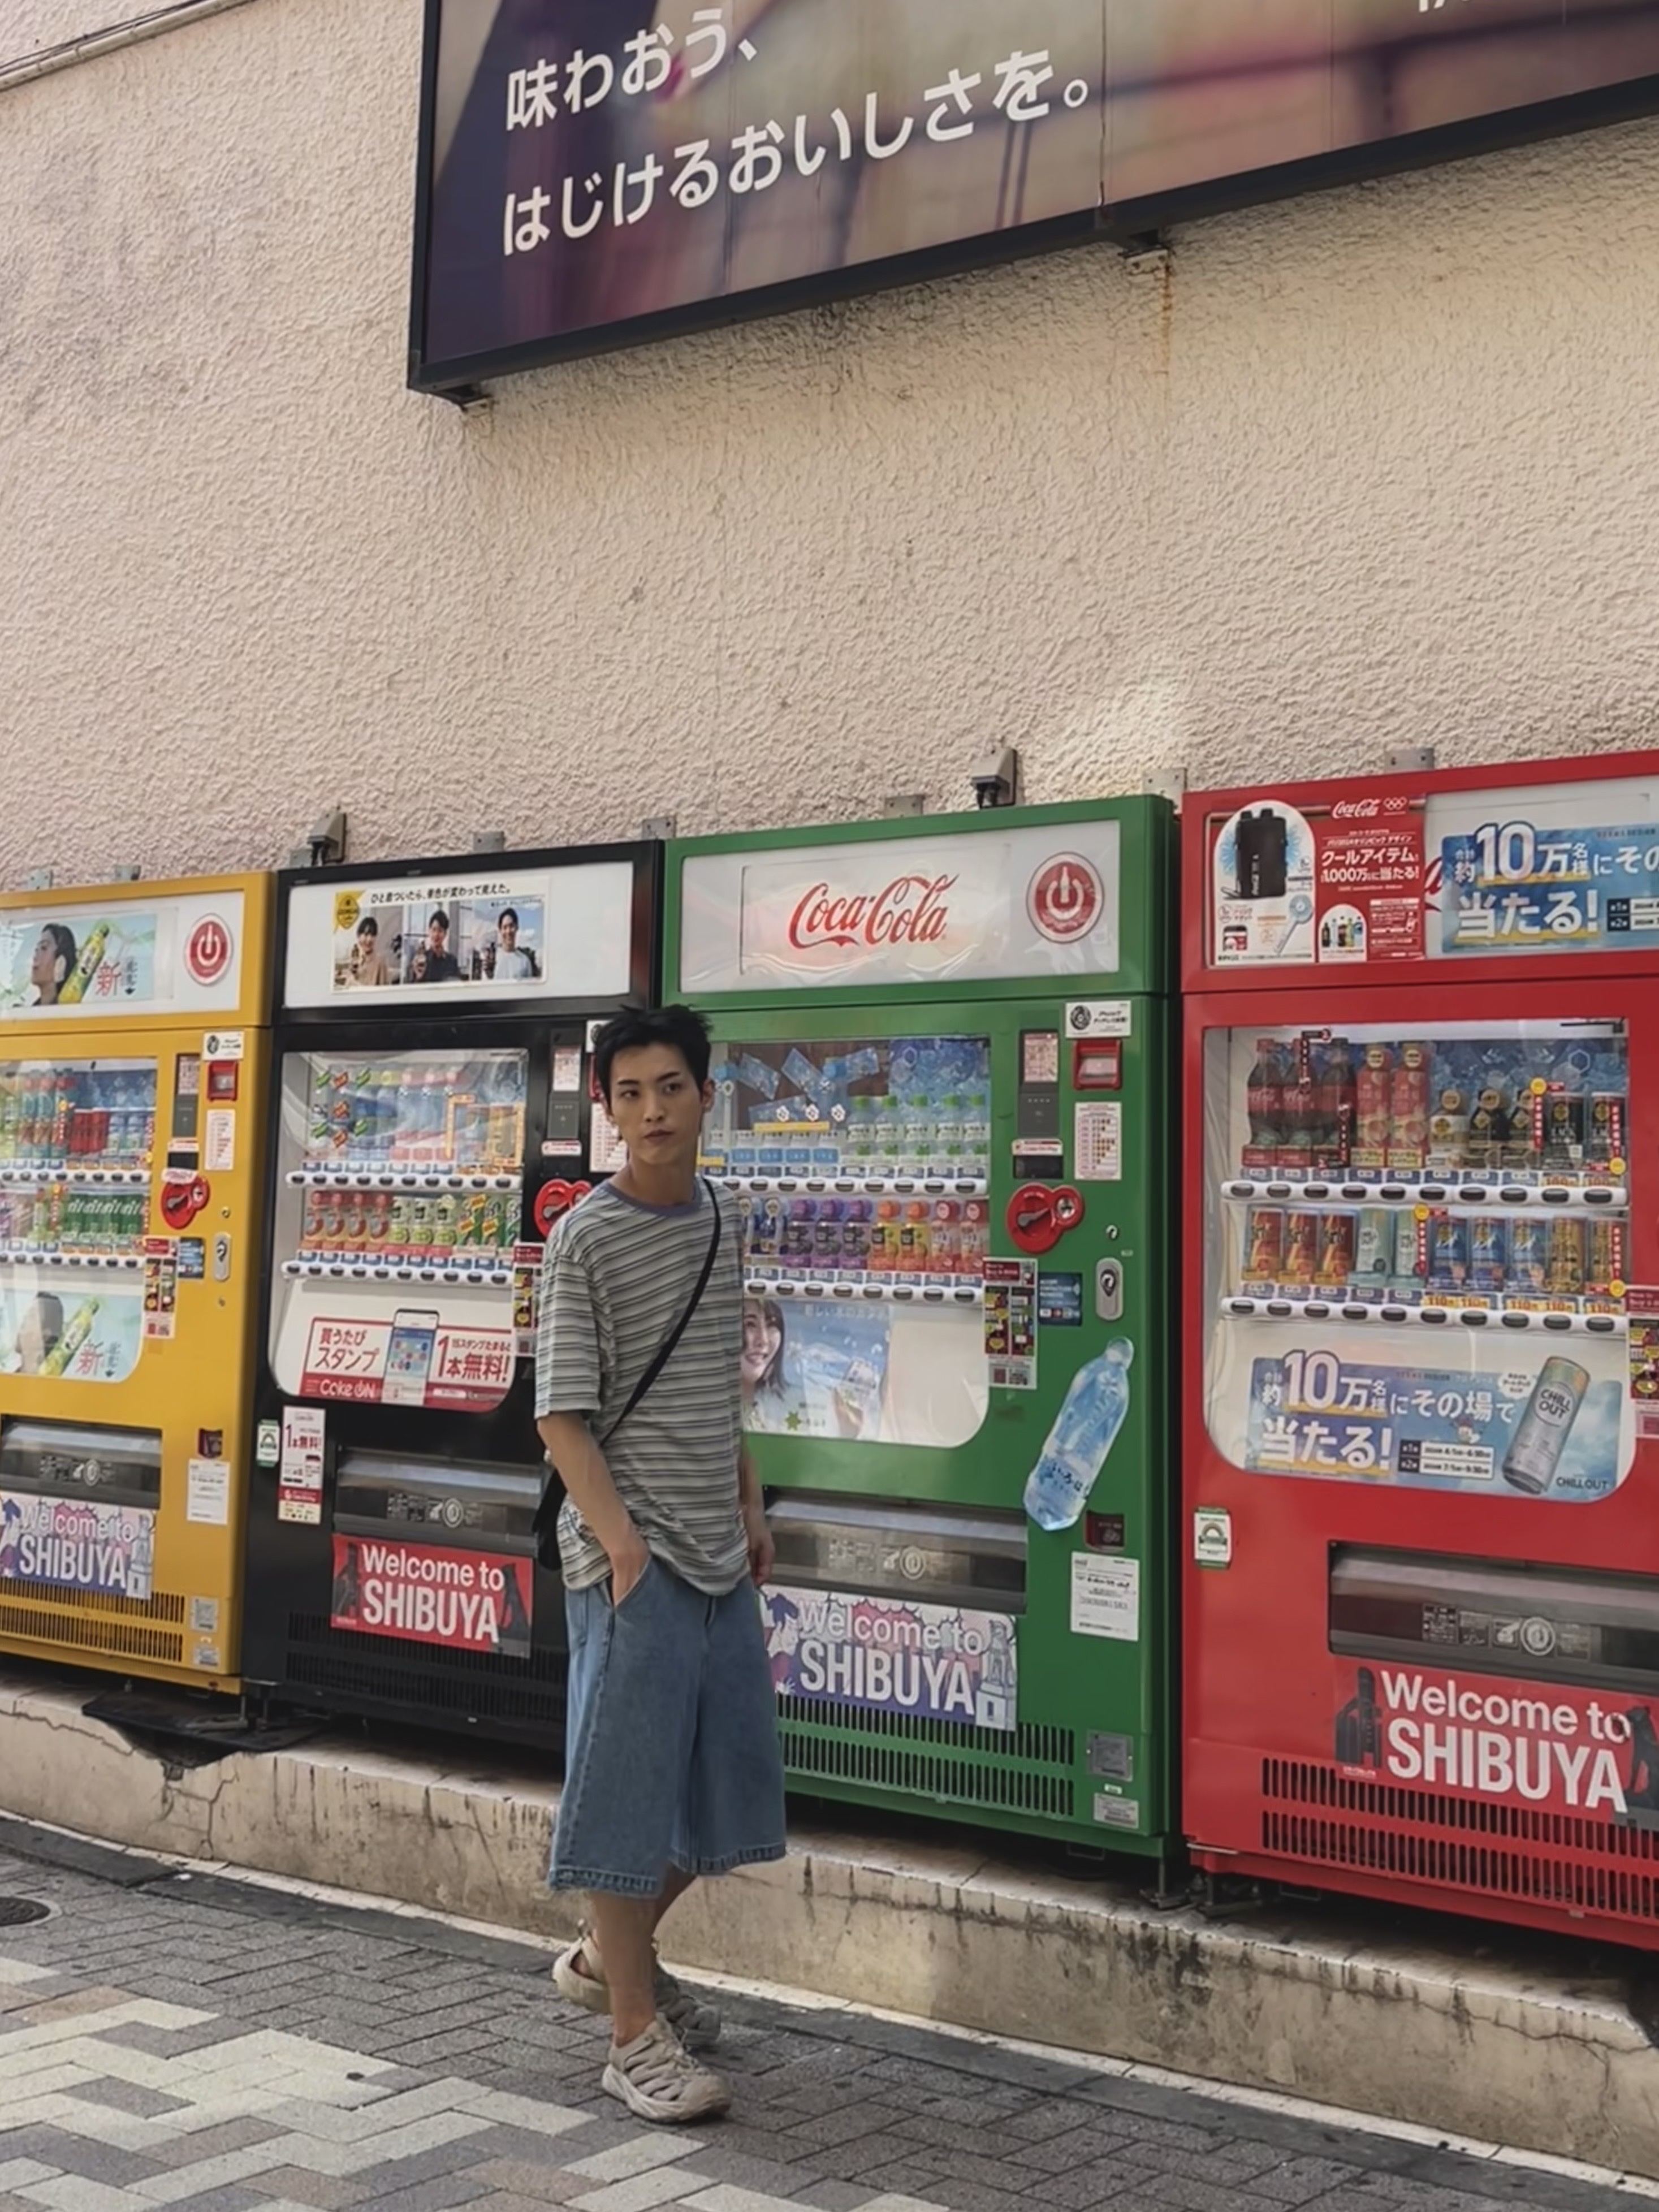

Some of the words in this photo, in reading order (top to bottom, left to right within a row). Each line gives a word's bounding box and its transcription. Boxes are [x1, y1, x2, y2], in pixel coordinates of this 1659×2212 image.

[505, 7, 758, 131] 味わおう、
[503, 49, 1088, 256] はじけるおいしさを。
[790, 873, 960, 949] Coca-Cola
[1457, 889, 1598, 939] 当たる!
[315, 1347, 380, 1372] スタンプ
[320, 1328, 367, 1346] 買うたび
[1539, 1400, 1566, 1419] OUT
[1540, 1389, 1570, 1412] CHILL
[1260, 1416, 1392, 1471] 当たる!
[1556, 1476, 1584, 1488] CHILL
[1584, 1479, 1608, 1490] OUT
[20, 1504, 110, 1539] Welcome
[19, 1533, 127, 1588] SHIBUYA
[362, 1544, 474, 1588] Welcome
[478, 1561, 505, 1591] to
[363, 1579, 499, 1643] SHIBUYA
[799, 1600, 941, 1650] Welcome
[952, 1624, 983, 1656] to
[800, 1640, 975, 1716] SHIBUYA
[1381, 1670, 1579, 1735] Welcome
[1586, 1701, 1632, 1744] to
[1387, 1717, 1628, 1813] SHIBUYA
